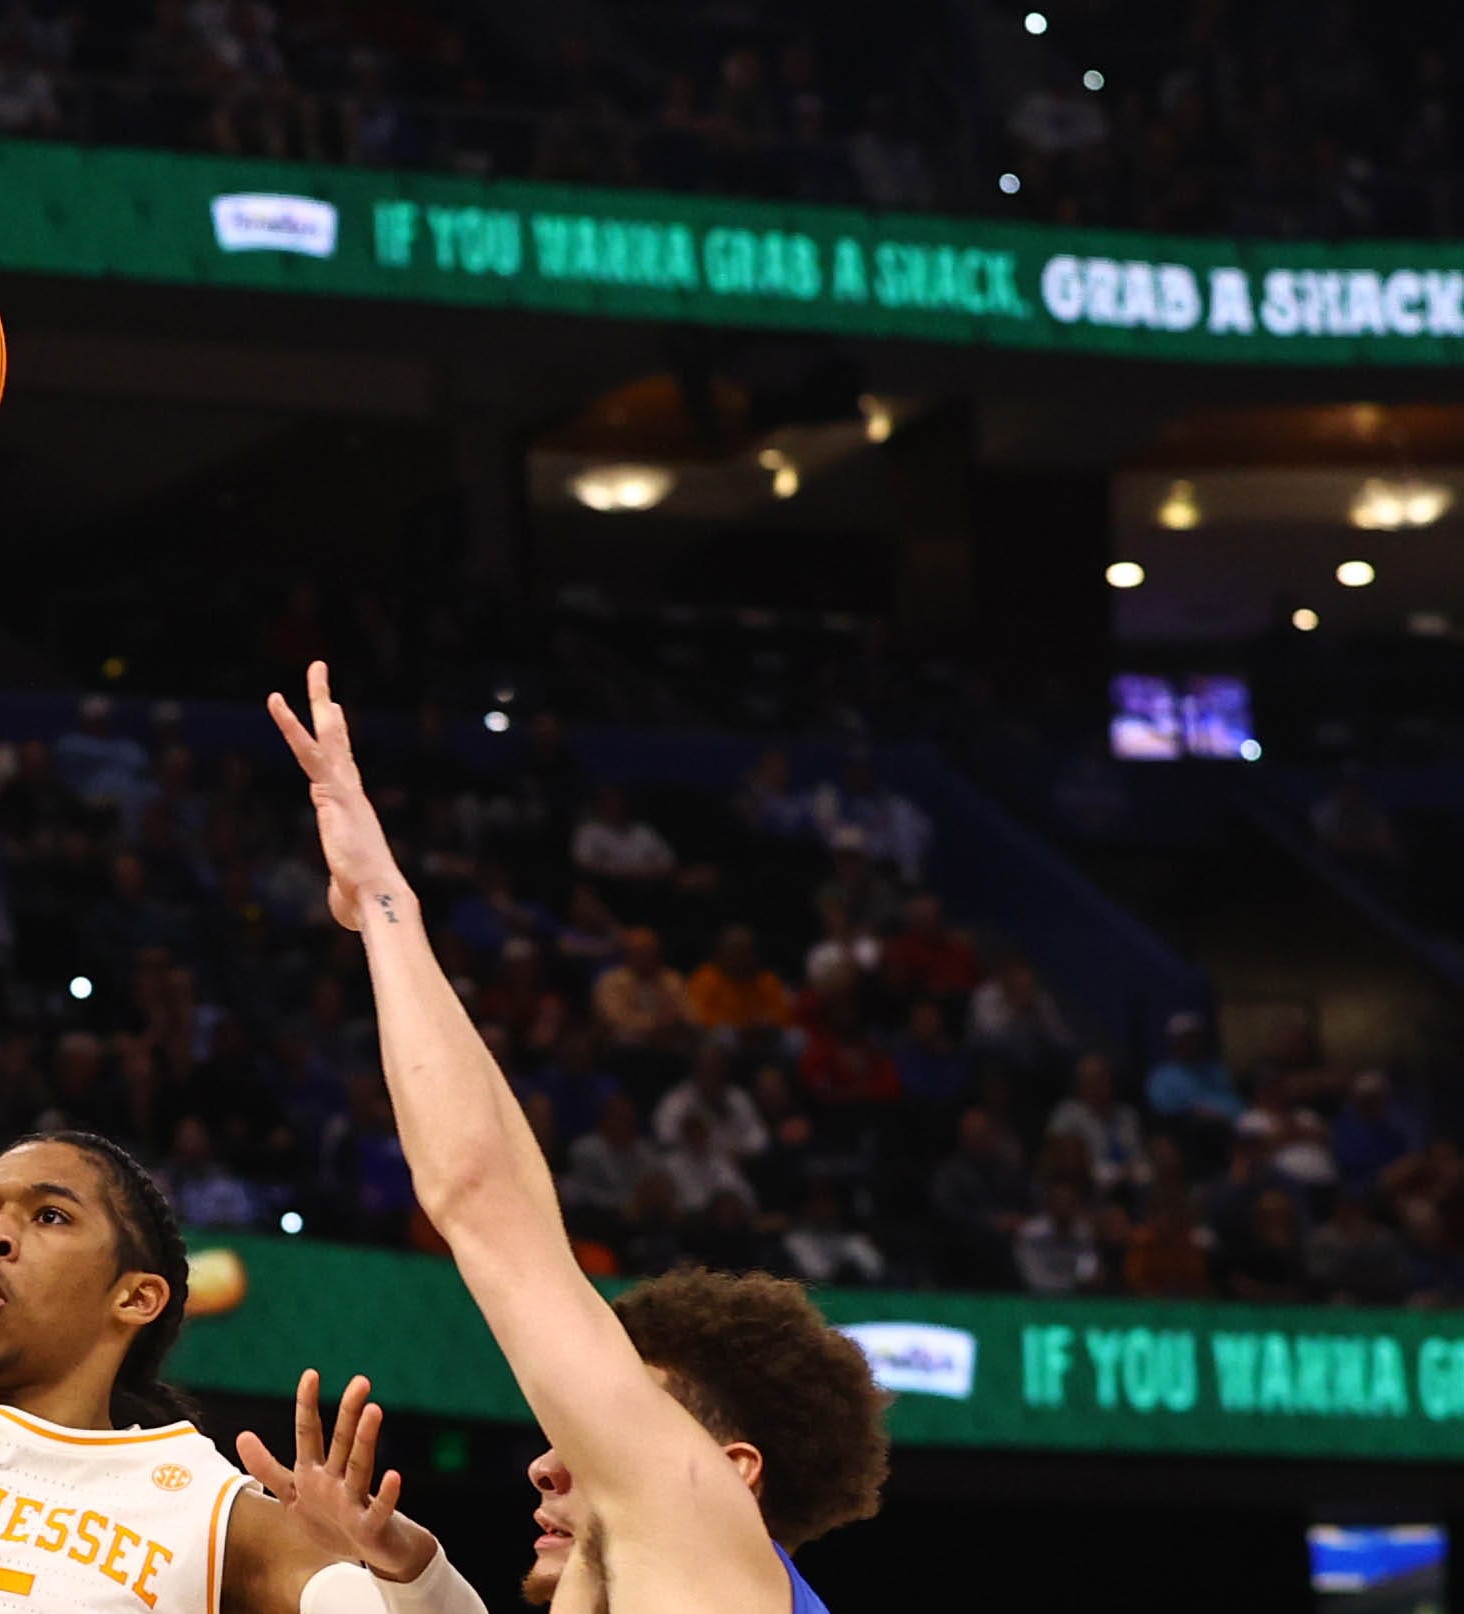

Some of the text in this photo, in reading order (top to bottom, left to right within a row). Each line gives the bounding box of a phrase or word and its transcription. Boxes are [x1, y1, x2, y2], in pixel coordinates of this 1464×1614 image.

[426, 206, 522, 276] YOU
[531, 214, 699, 288] WANNA
[703, 228, 822, 300] GRAB
[832, 237, 869, 304] A
[1040, 253, 1202, 331] GRAB
[1208, 266, 1256, 334] A
[1021, 1324, 1074, 1408] IF
[1085, 1326, 1198, 1414] YOU
[1211, 1331, 1409, 1418] WANNA
[155, 1465, 190, 1490] SEC
